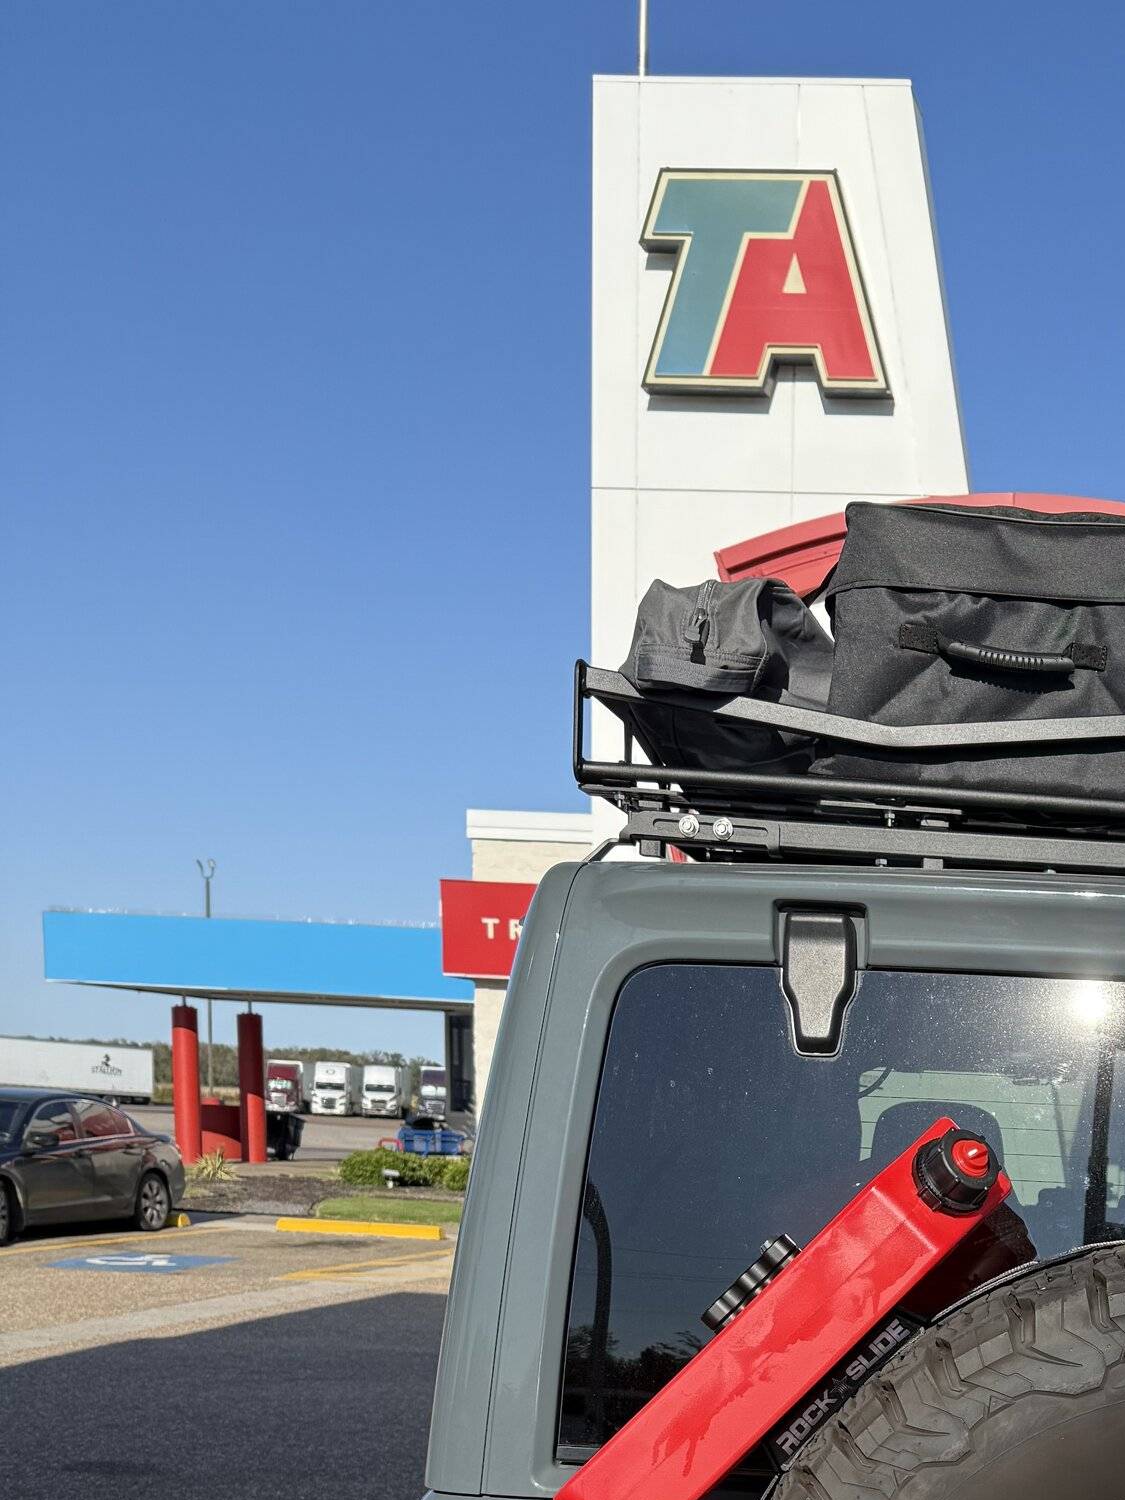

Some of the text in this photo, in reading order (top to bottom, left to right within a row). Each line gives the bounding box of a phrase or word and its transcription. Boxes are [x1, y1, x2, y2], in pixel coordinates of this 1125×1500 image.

[639, 167, 893, 399] TA
[776, 1318, 911, 1456] ROCK SLIDE
